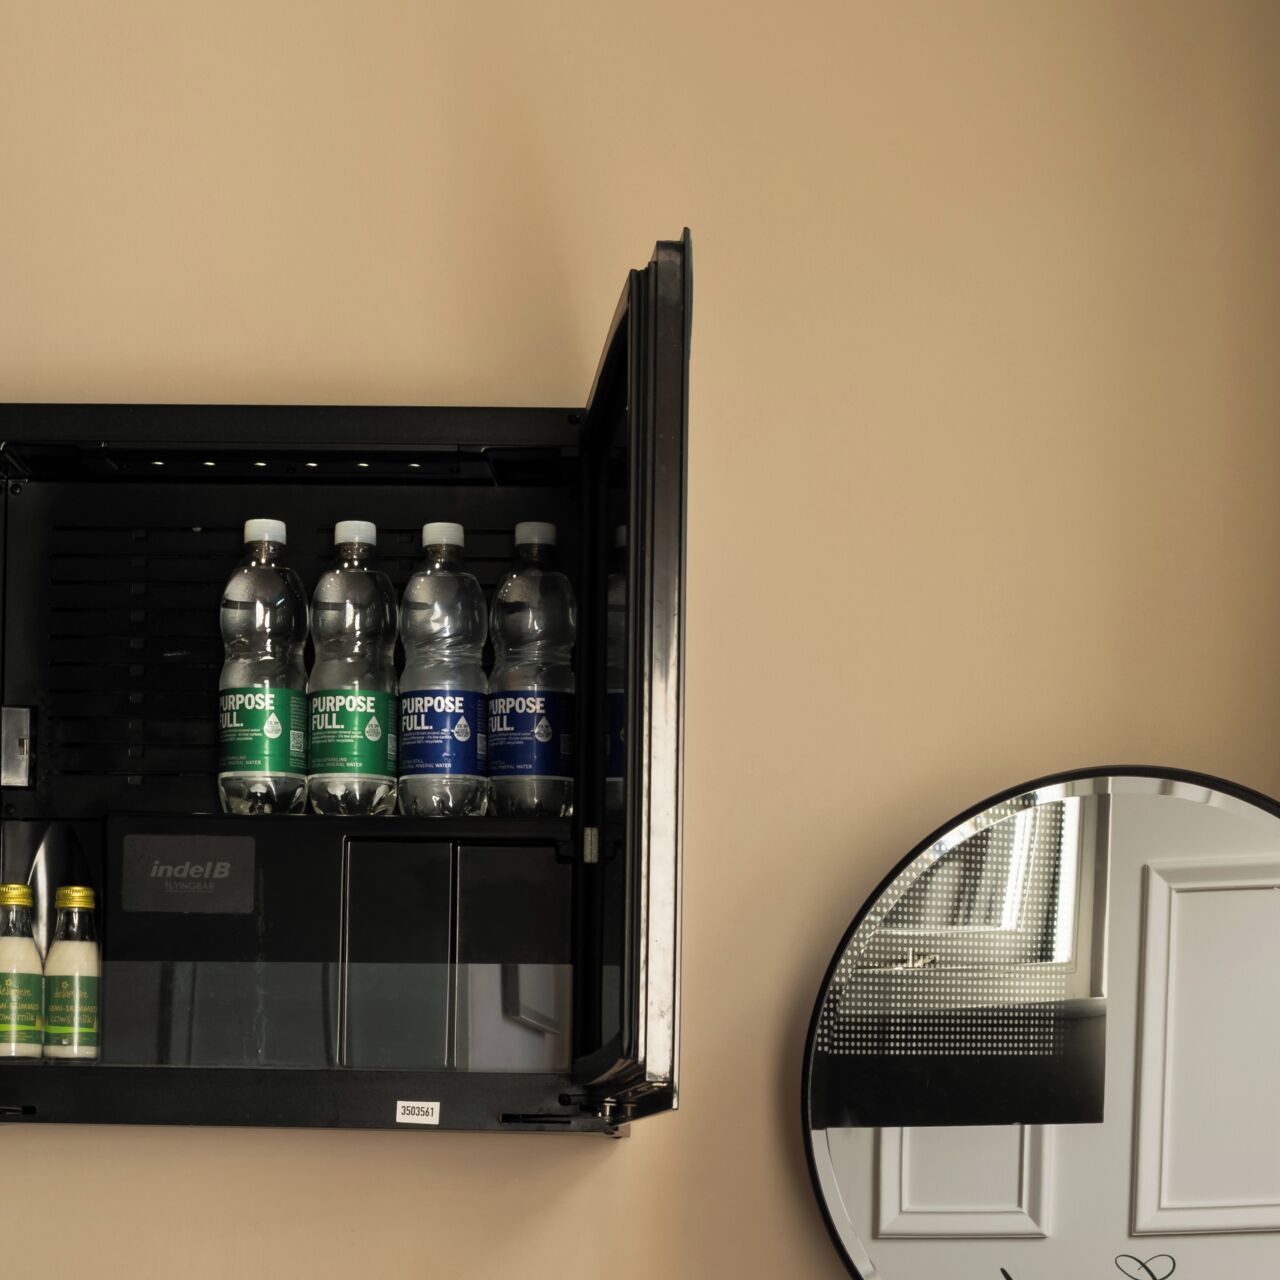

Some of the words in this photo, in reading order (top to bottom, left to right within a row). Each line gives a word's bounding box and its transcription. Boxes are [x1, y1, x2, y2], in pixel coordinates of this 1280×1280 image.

[312, 696, 376, 713] PURPOSE
[402, 696, 464, 714] PURPOSE
[312, 713, 344, 730] FULL.
[402, 714, 433, 732] FULL.
[401, 1105, 434, 1117] 3503561
